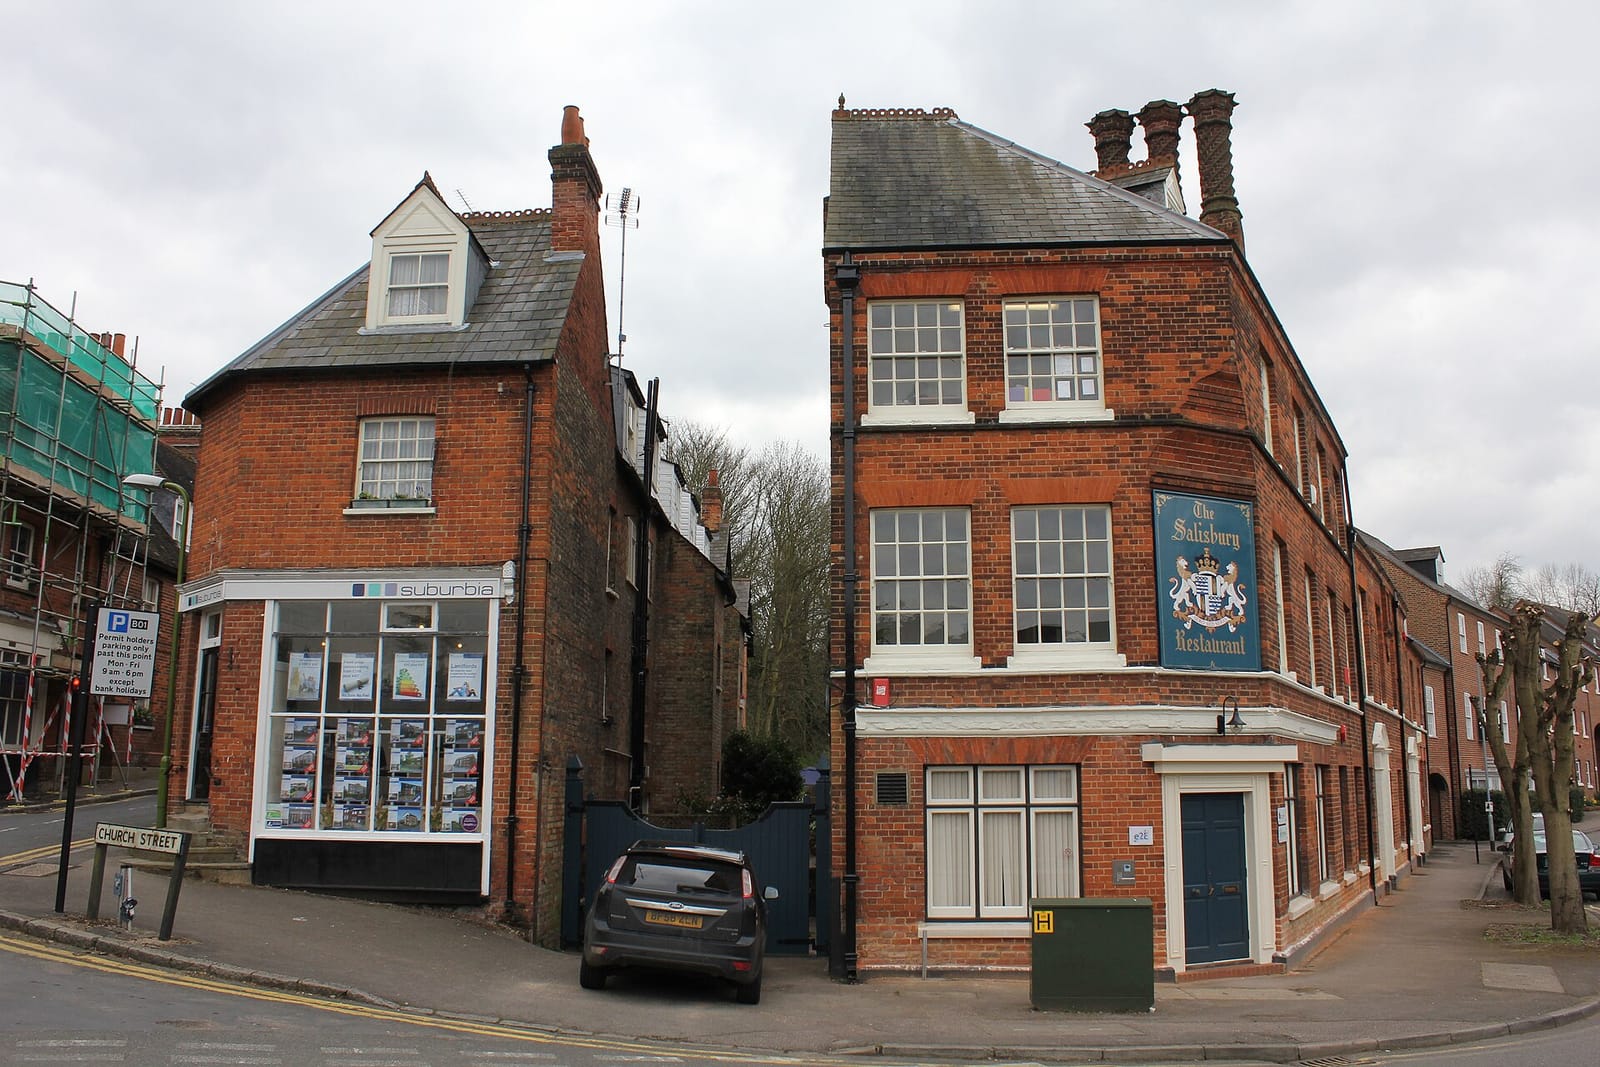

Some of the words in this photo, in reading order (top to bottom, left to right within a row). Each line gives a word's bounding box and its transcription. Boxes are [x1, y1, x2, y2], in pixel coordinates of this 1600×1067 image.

[1193, 500, 1215, 520] The
[1171, 518, 1241, 551] Salisbury
[400, 582, 494, 597] suburbia
[111, 614, 125, 631] P
[131, 620, 148, 629] B01
[98, 633, 124, 642] Permit
[126, 636, 154, 645] holders
[1175, 629, 1246, 656] Restaurant
[97, 650, 114, 658] past
[116, 651, 130, 659] this
[132, 653, 152, 661] point
[102, 643, 131, 652] parking
[132, 645, 150, 653] only
[107, 660, 124, 668] Mon
[129, 661, 140, 669] Fri
[95, 684, 115, 693] bank
[116, 686, 147, 695] holidays
[109, 679, 135, 687] except
[98, 828, 135, 844] CHURCH
[140, 833, 178, 849] STREET
[1037, 913, 1050, 930] H
